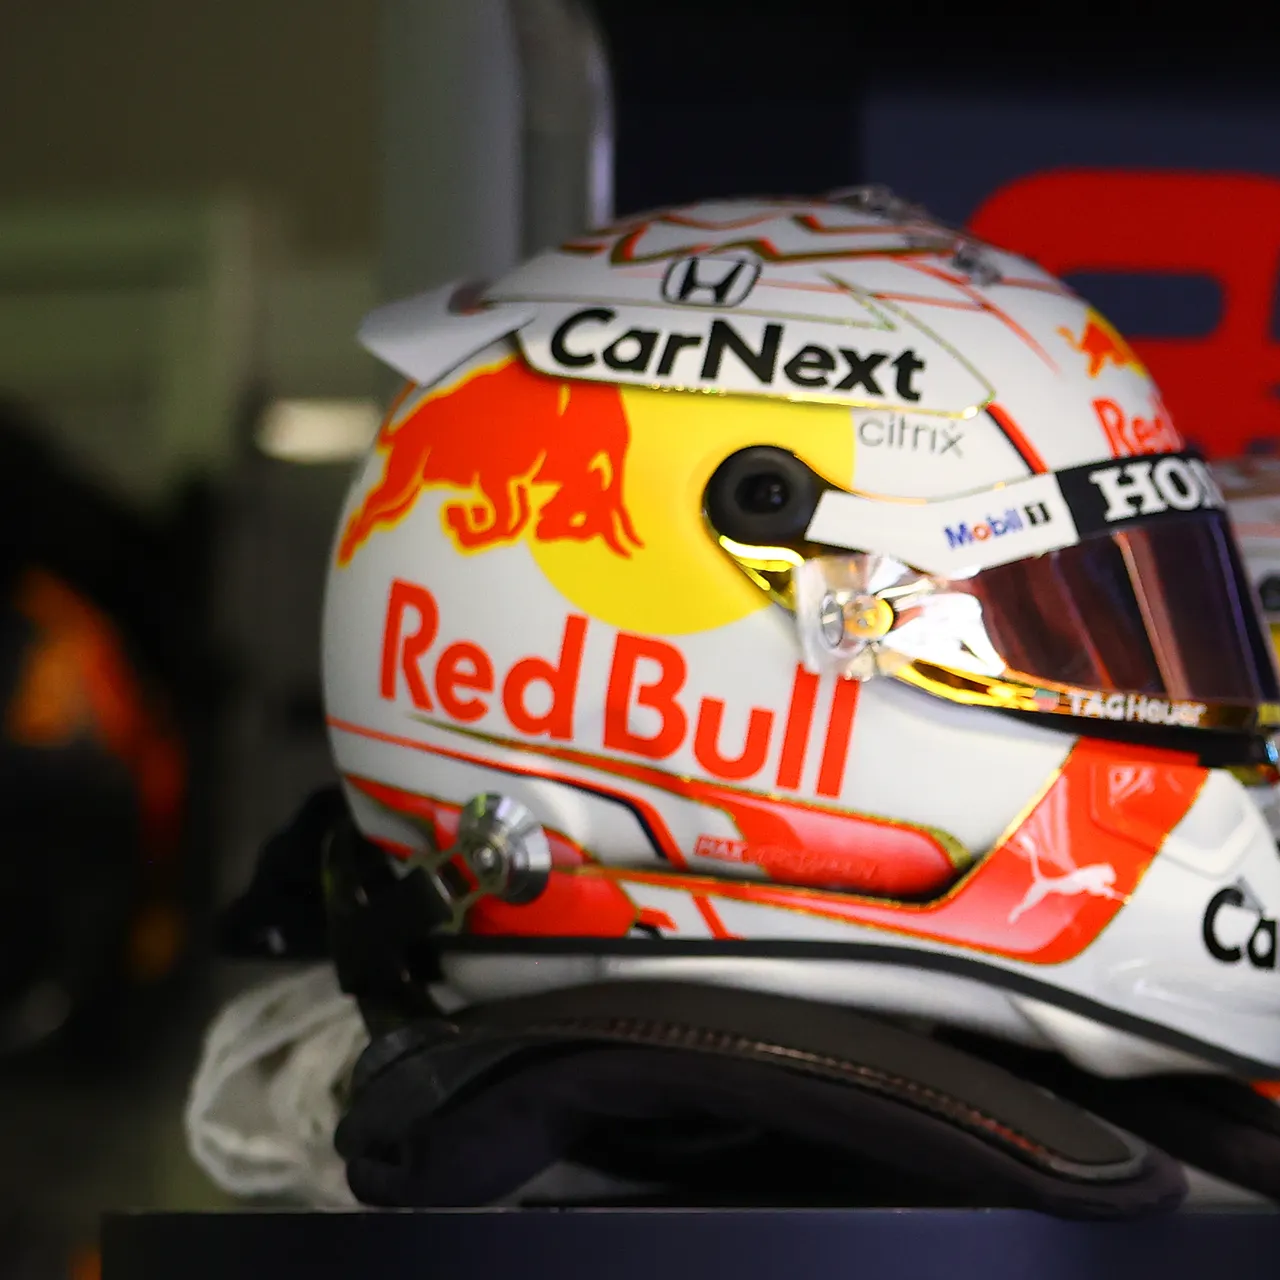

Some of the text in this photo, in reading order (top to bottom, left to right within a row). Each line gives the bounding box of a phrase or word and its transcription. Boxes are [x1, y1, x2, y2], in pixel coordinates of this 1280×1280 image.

[550, 307, 925, 402] CarNext
[858, 414, 965, 458] citrix
[943, 508, 1023, 549] Mobil
[379, 578, 861, 799] Red Bull
